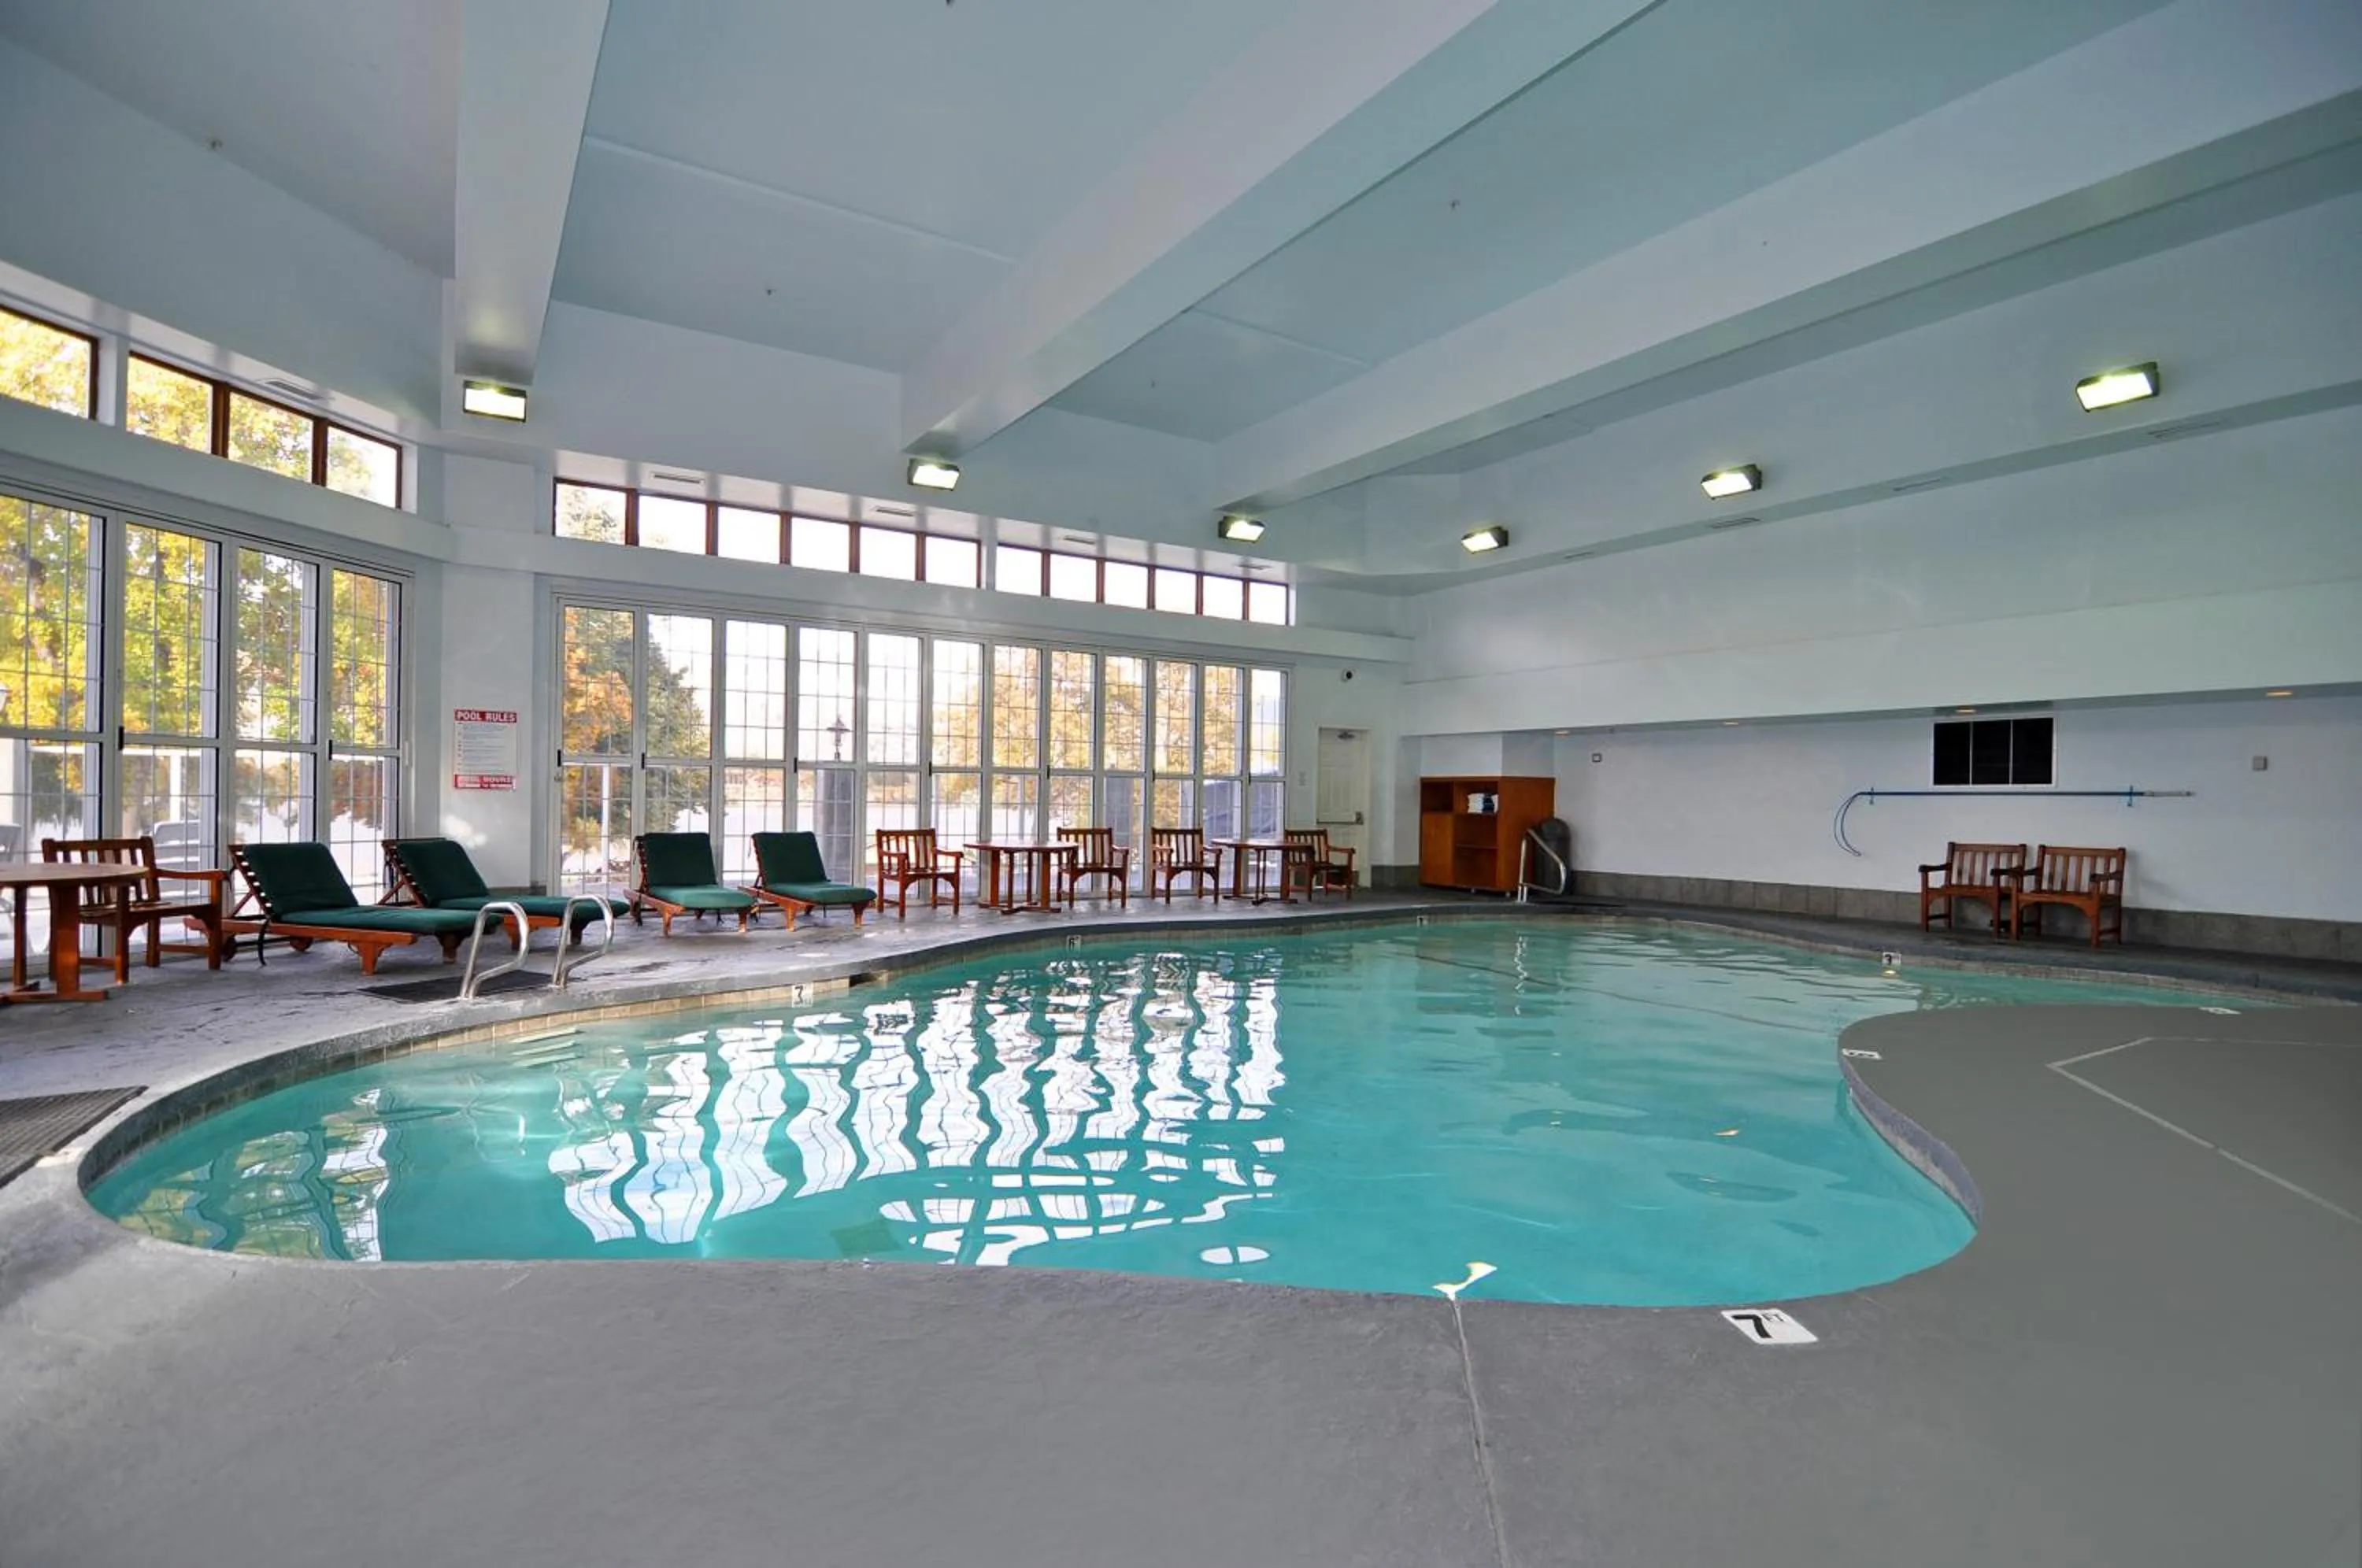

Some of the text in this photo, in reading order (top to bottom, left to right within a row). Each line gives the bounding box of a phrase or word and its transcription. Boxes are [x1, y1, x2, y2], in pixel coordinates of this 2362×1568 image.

[457, 711, 516, 722] POOL RULES
[1731, 1314, 1772, 1339] 7
